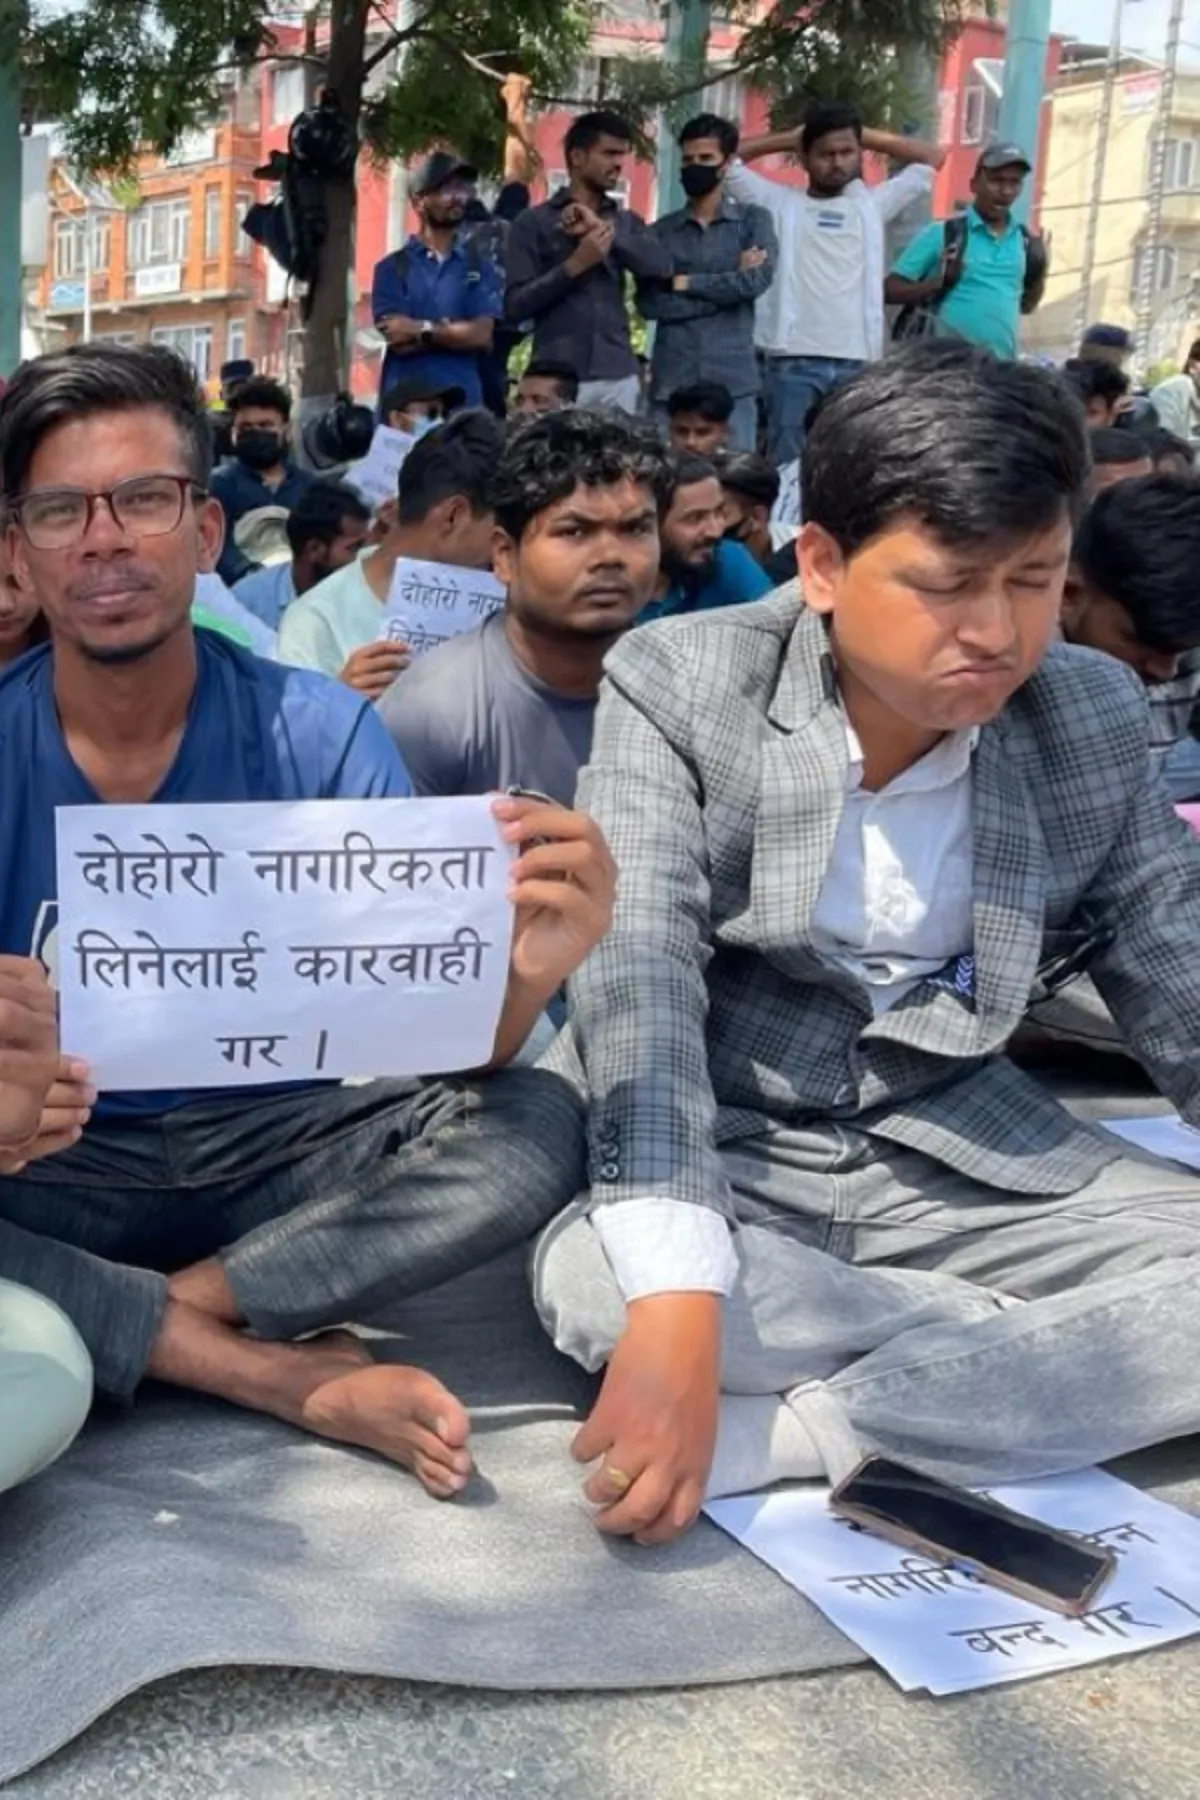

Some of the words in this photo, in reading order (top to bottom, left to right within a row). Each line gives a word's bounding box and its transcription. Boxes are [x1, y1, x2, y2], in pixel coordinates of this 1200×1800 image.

[400, 572, 461, 612] दोहोरो
[74, 832, 226, 901] दोहोरो
[247, 830, 495, 894] नागरिकता
[73, 928, 267, 993] लिनेलाई
[288, 925, 491, 987] कारवाही
[214, 1033, 289, 1069] गर
